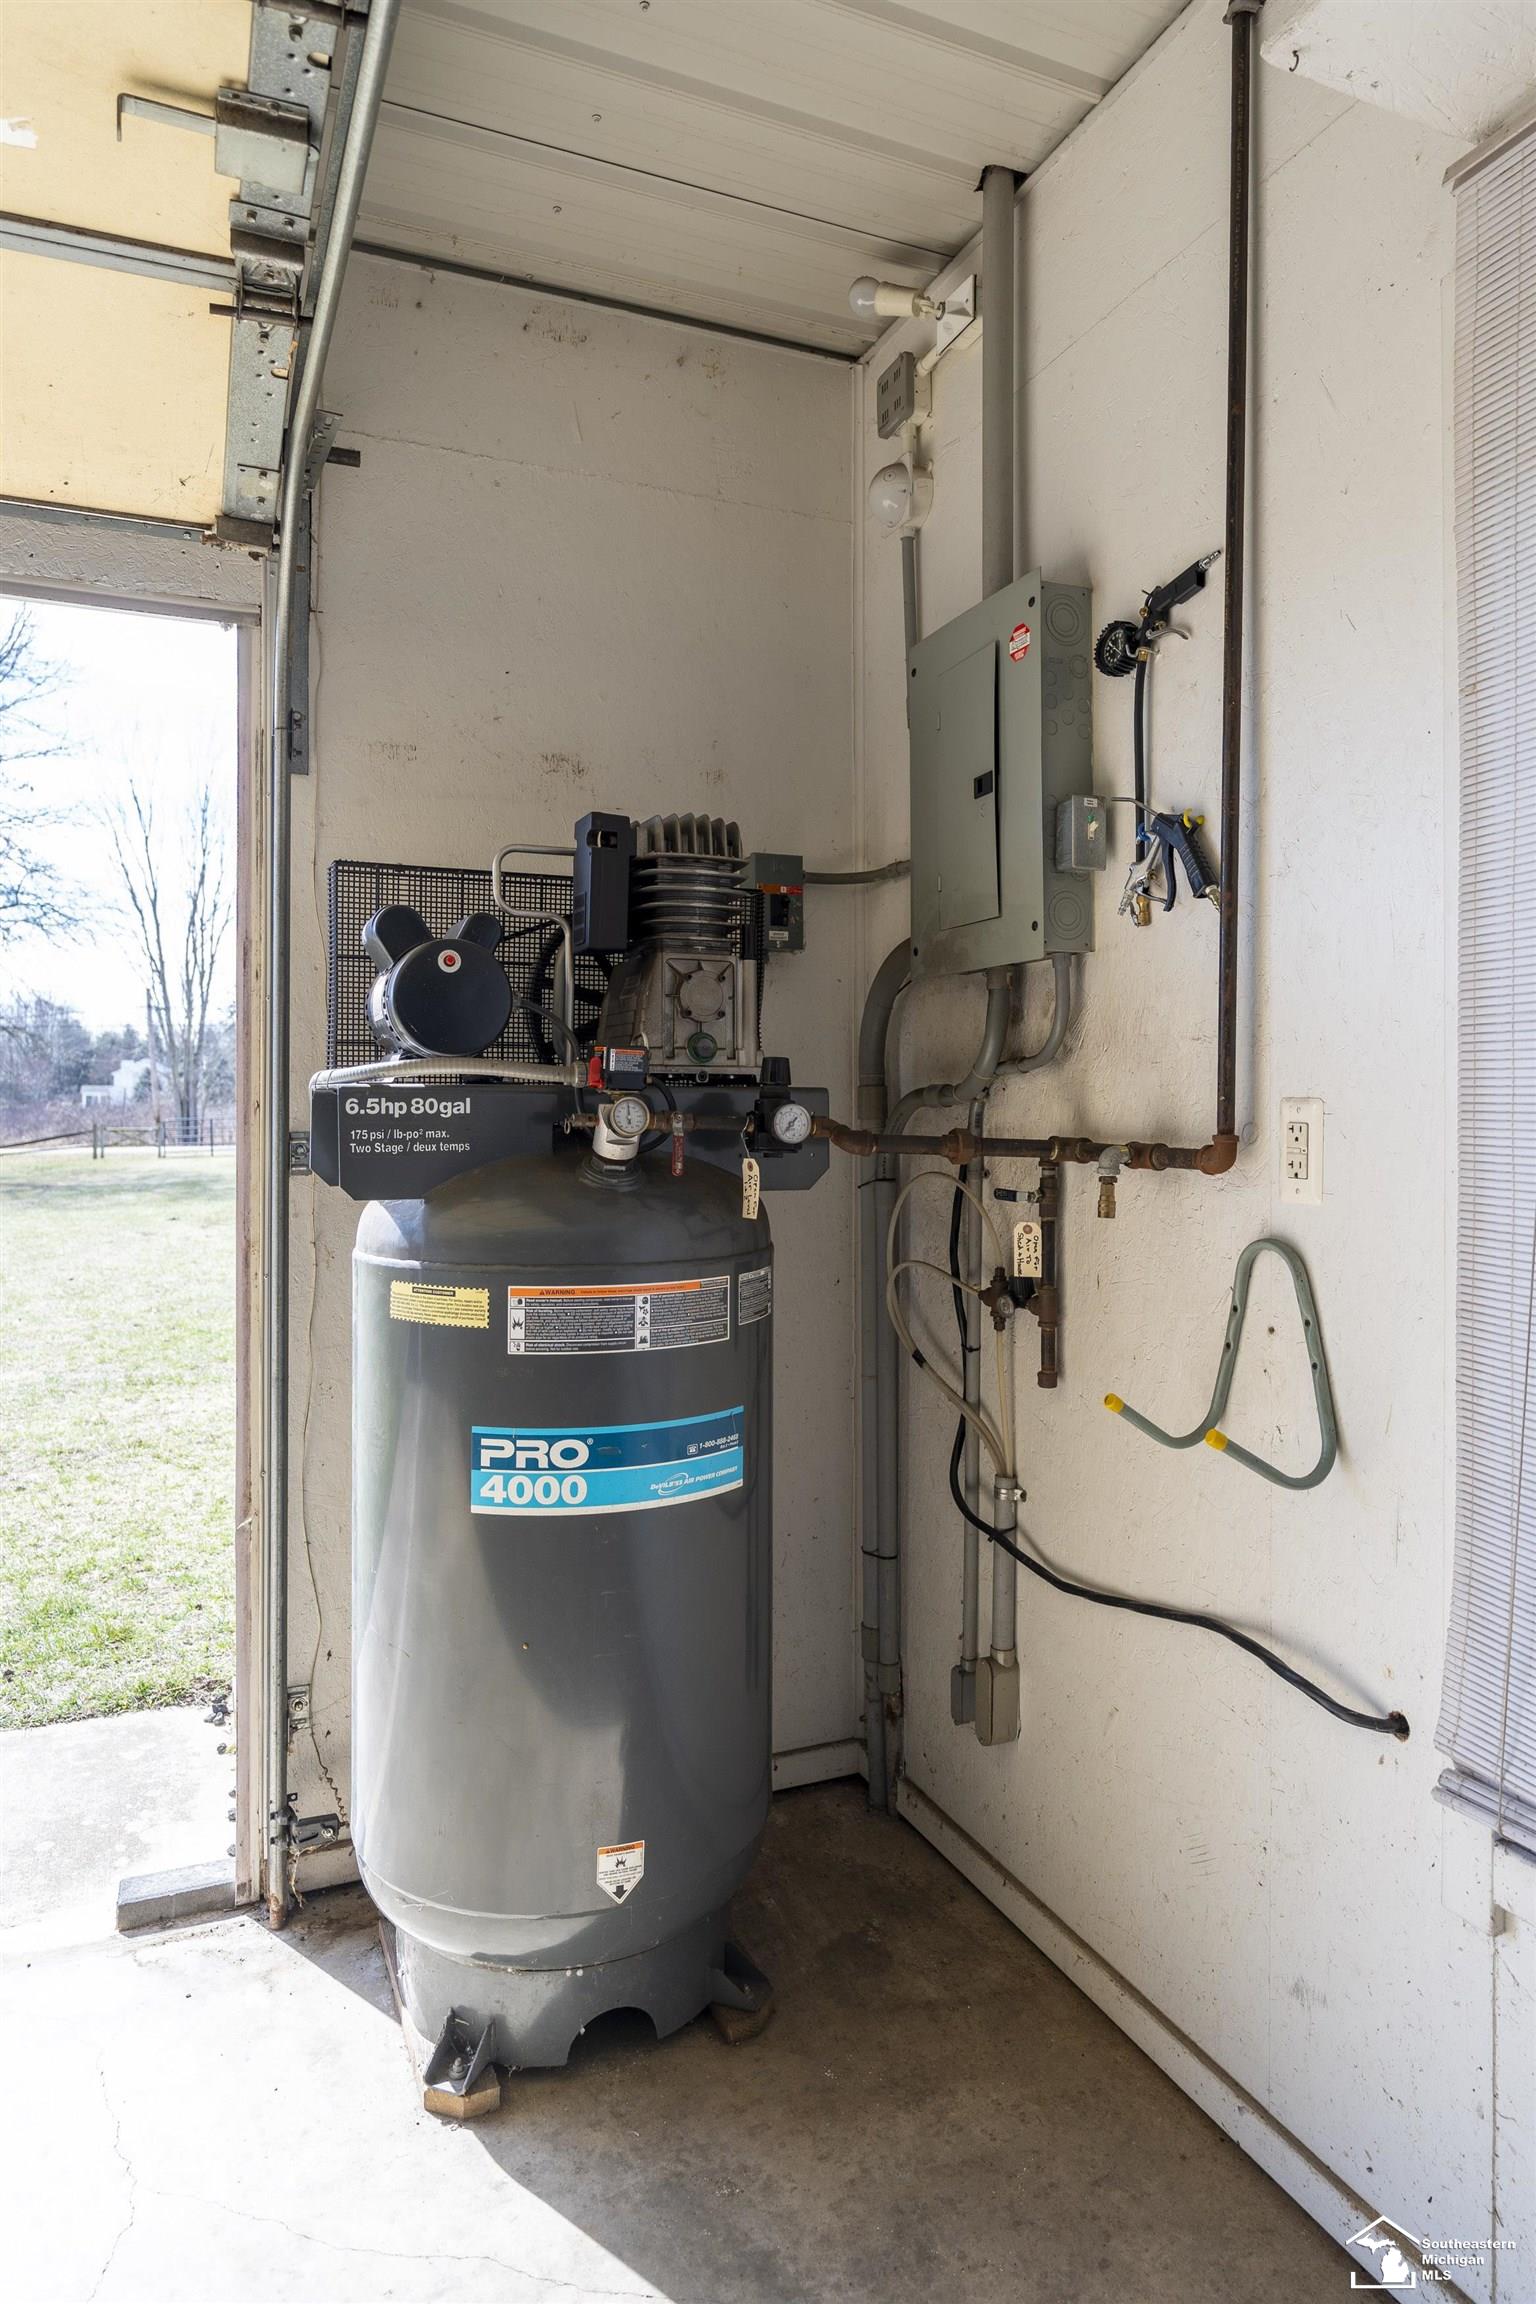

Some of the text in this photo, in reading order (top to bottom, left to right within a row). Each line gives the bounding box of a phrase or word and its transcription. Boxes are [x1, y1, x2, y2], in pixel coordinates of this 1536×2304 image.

[345, 1097, 471, 1118] 6.5hp 80gal
[350, 1129, 368, 1140] 175
[370, 1129, 385, 1141] psi
[425, 1129, 450, 1139] max.
[350, 1143, 371, 1153] Two
[374, 1142, 404, 1155] Stage
[412, 1142, 437, 1152] deux
[440, 1142, 470, 1153] temps
[683, 1476, 695, 1485] AIR
[695, 1472, 716, 1483] POWER
[480, 1474, 588, 1505] 4000
